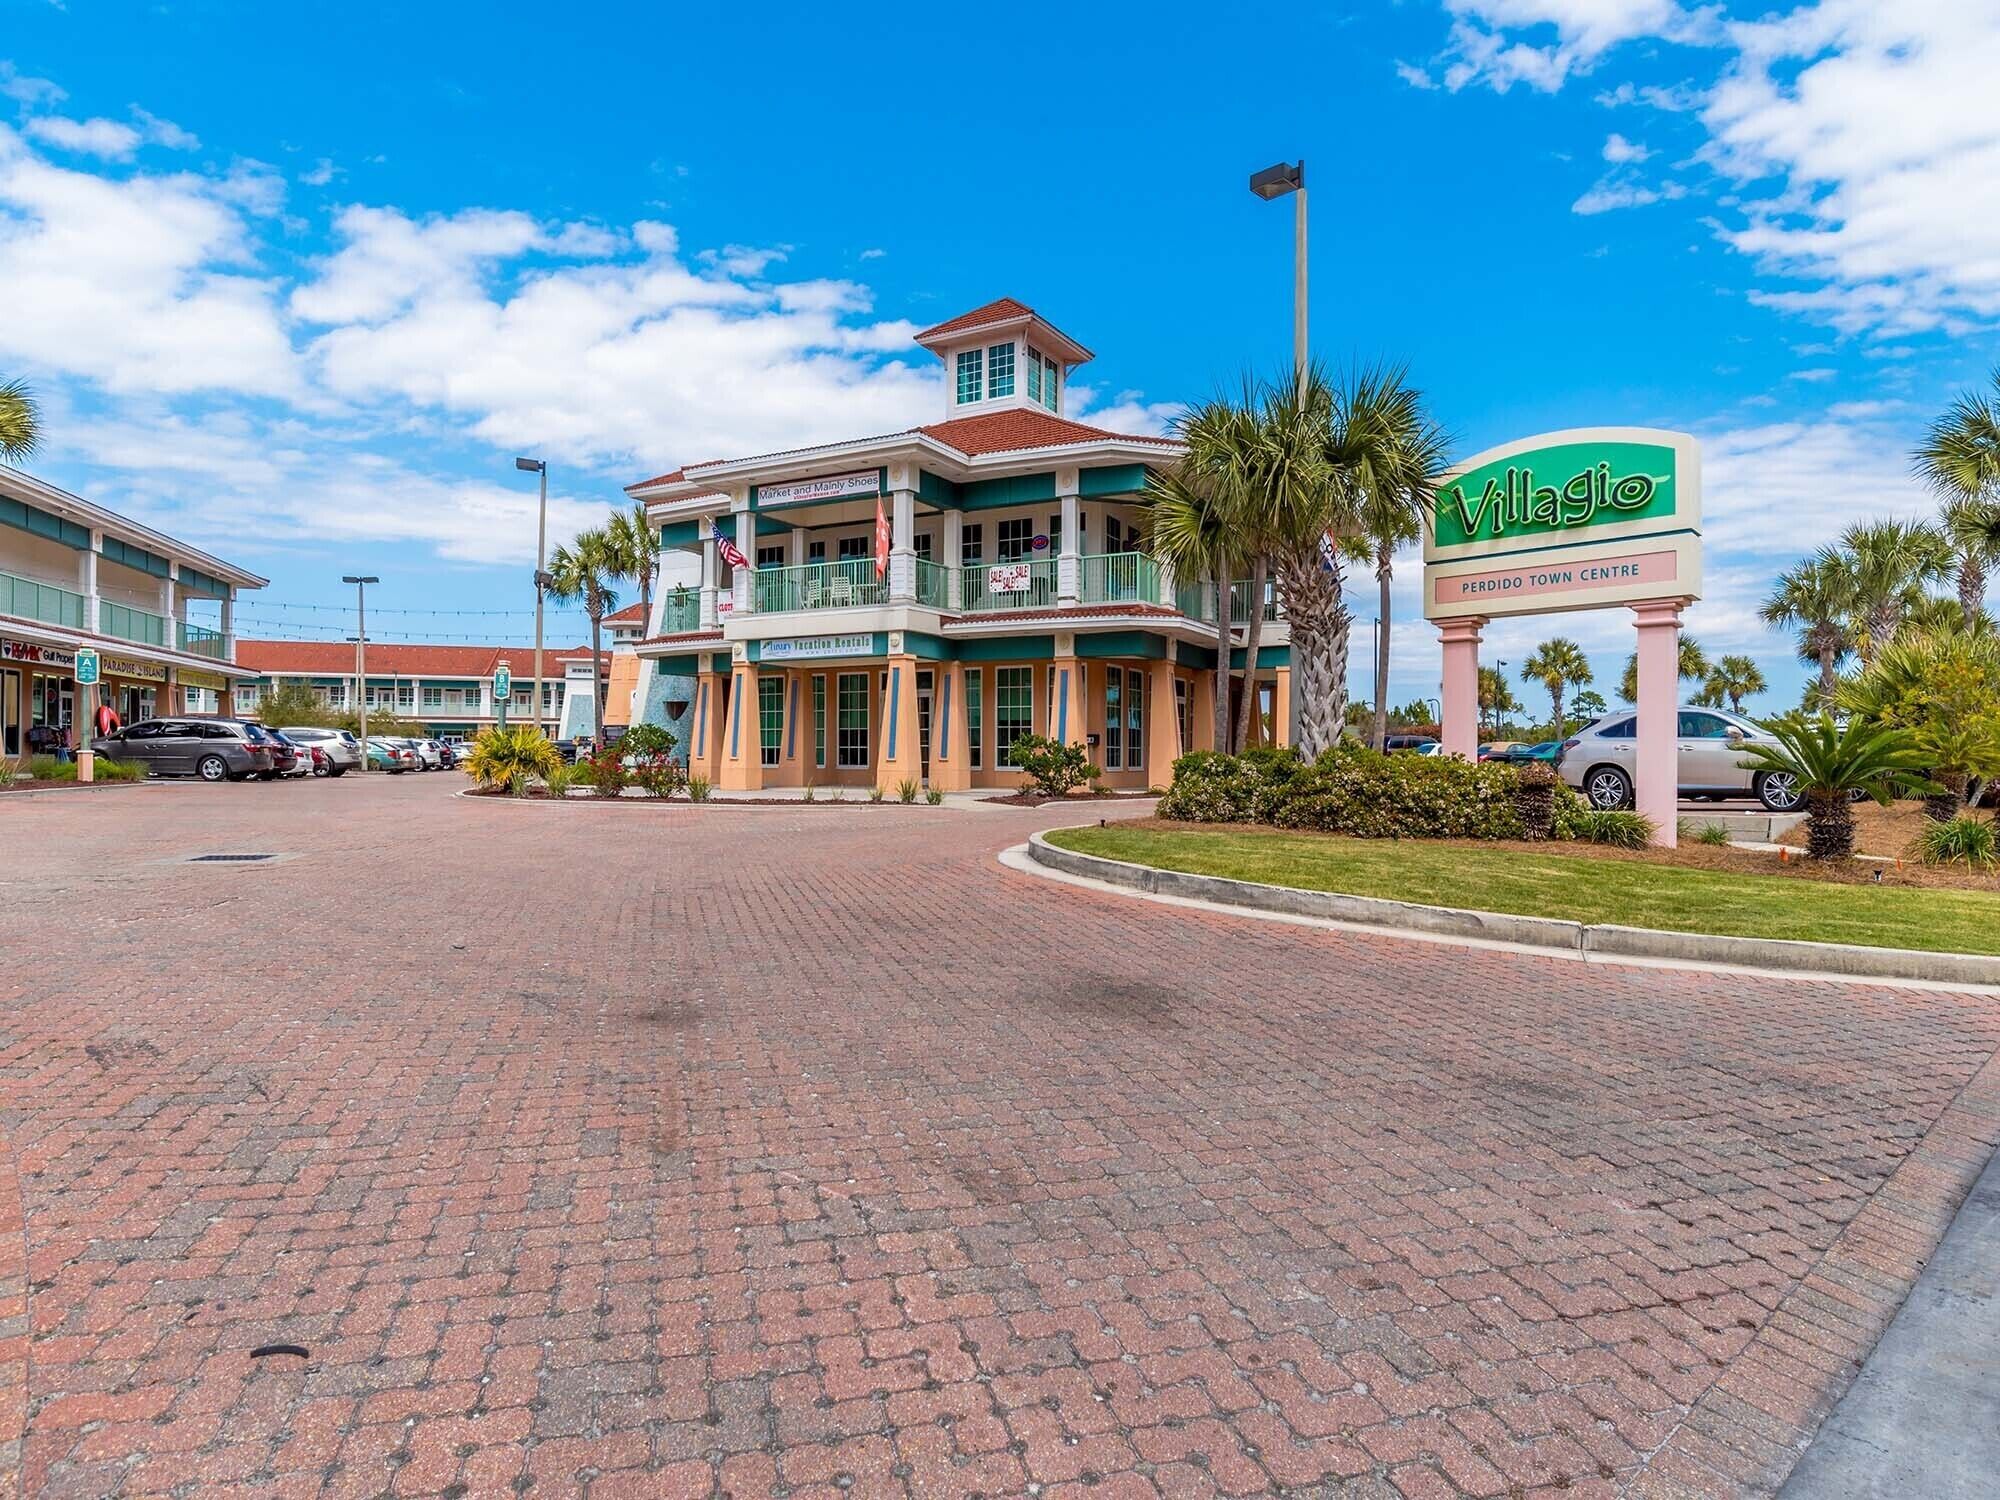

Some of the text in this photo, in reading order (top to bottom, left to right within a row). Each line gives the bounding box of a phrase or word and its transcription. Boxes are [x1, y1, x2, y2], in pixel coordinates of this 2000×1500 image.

[759, 476, 878, 500] Market and Mainly Shoes
[1452, 461, 1656, 536] Villagio
[1462, 563, 1640, 593] PERDIDO TOWN CENTRE
[12, 642, 42, 662] RE/MAX
[43, 650, 56, 660] Gulf
[794, 638, 831, 650] Vacation
[834, 635, 870, 649] Rentals
[82, 657, 92, 667] A
[103, 658, 135, 674] PARADISE
[143, 667, 165, 679] ISLAND
